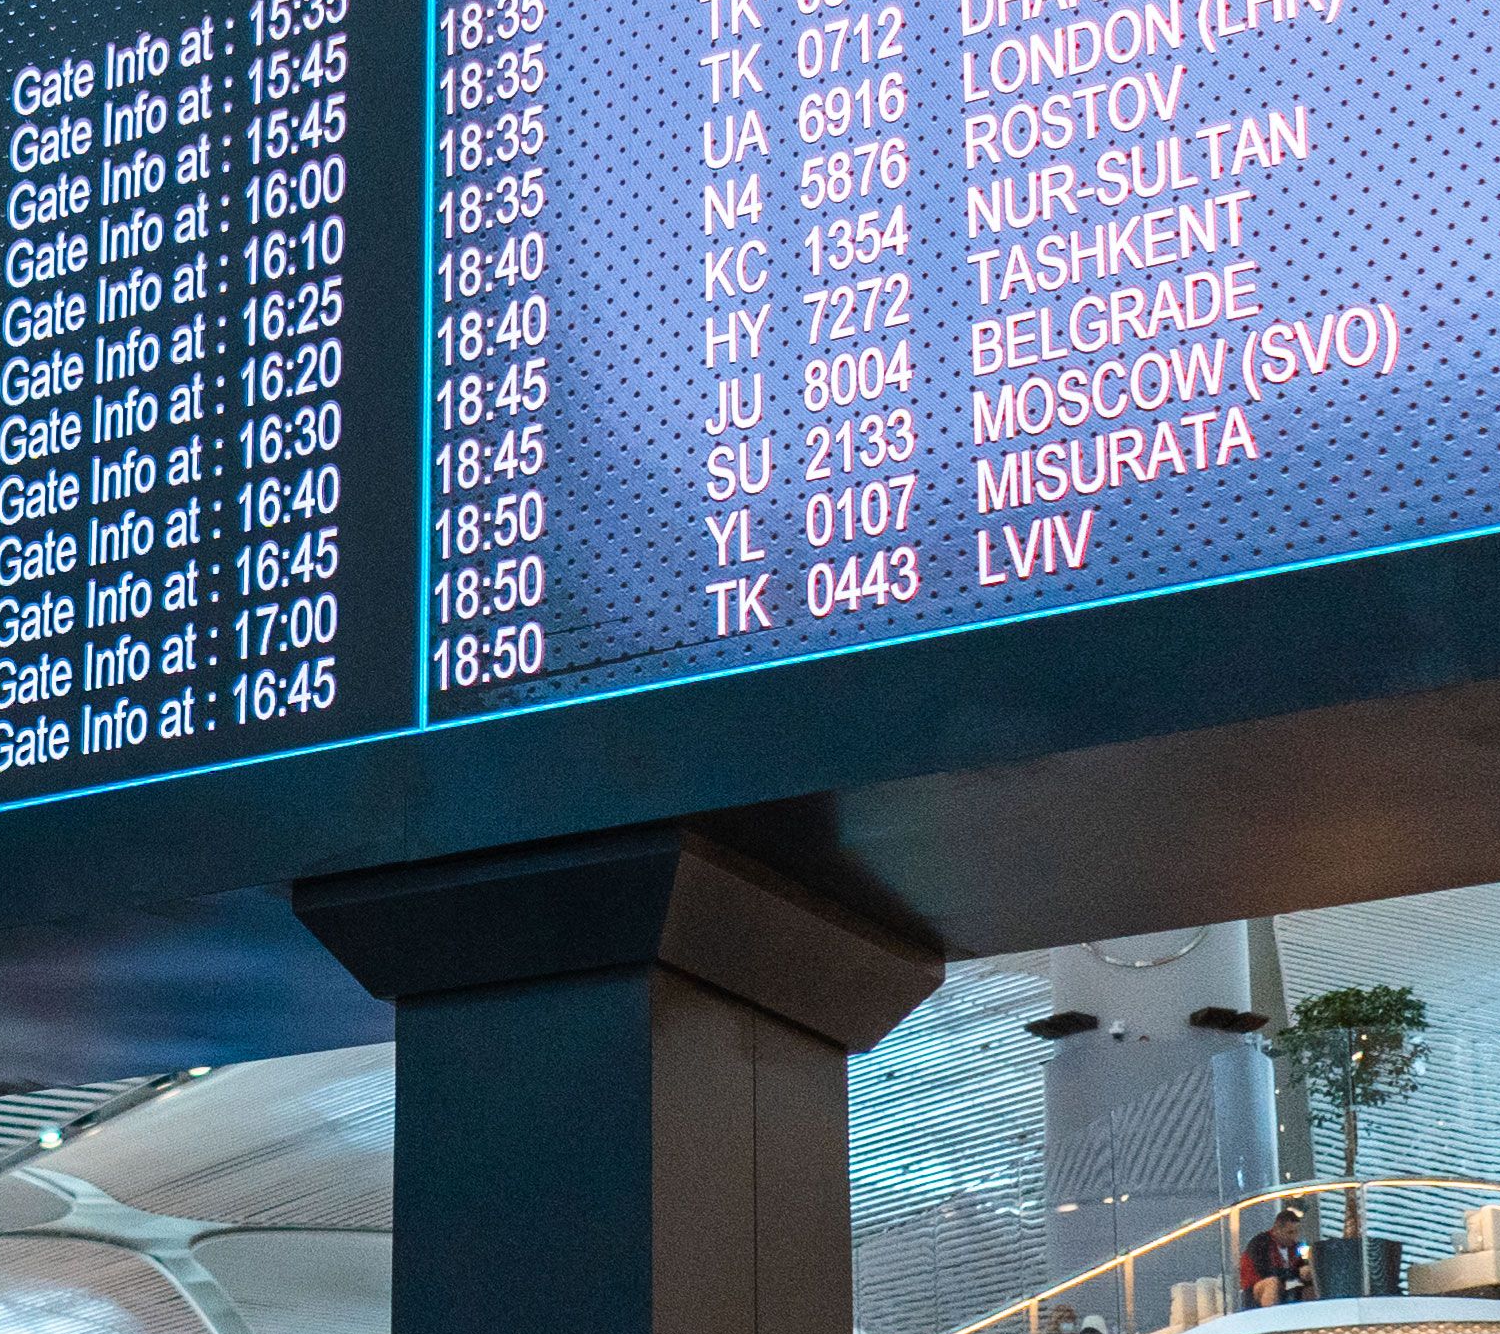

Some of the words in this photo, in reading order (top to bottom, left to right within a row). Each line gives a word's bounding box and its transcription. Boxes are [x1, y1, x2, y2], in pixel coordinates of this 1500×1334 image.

[437, 293, 548, 366] 18:40
[703, 237, 769, 302] KC
[803, 202, 911, 276] 1354
[965, 103, 1311, 239] NUR-SULTAN
[92, 384, 159, 445] Info
[167, 370, 205, 426] at
[240, 336, 344, 408] 16:20
